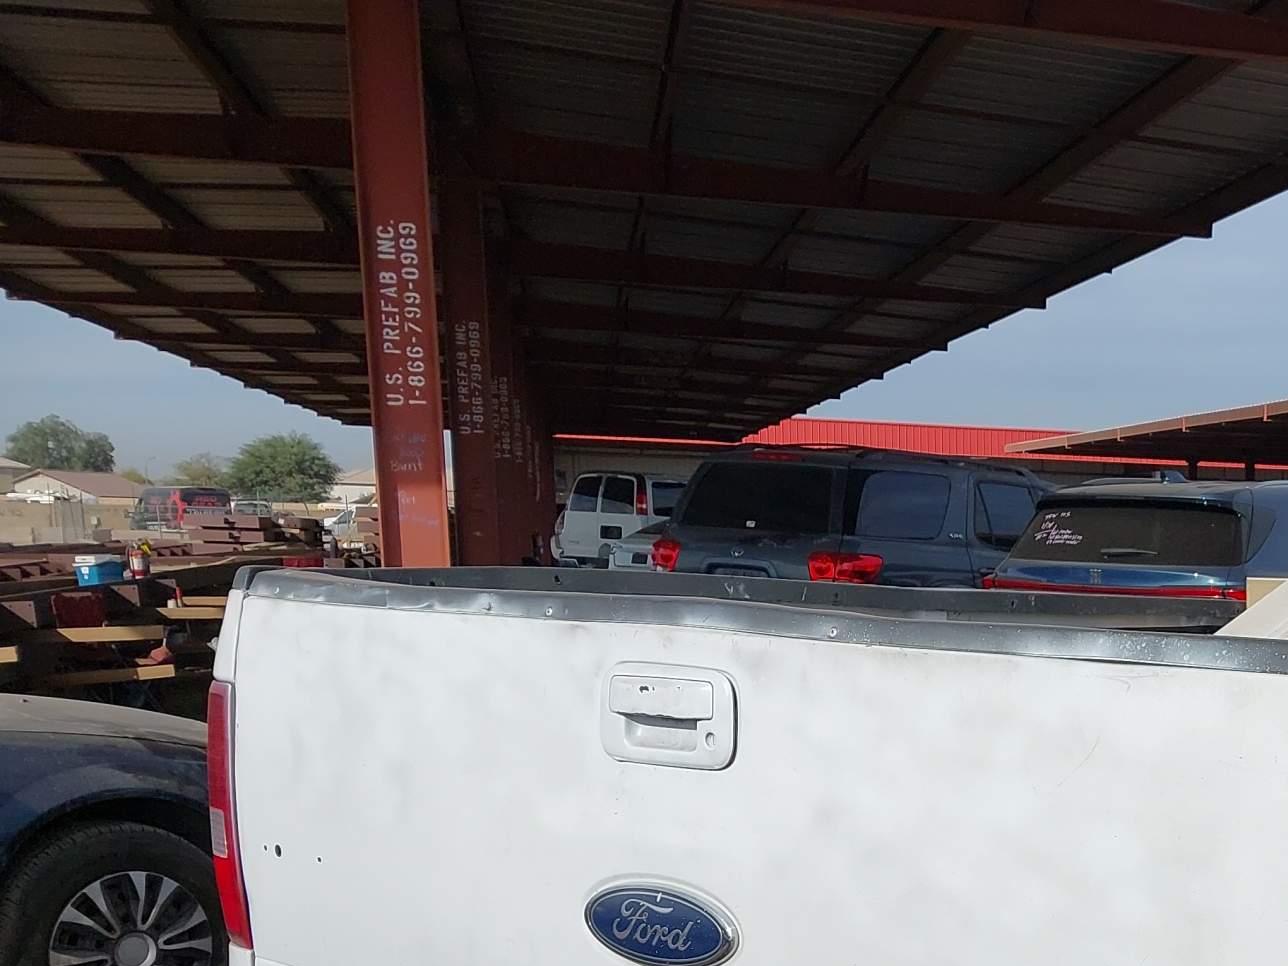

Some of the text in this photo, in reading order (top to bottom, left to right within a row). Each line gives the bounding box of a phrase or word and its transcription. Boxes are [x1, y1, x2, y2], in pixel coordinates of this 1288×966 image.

[376, 219, 404, 406] U.S. PREFAB INC.
[398, 222, 428, 405] 1-866-799-0969
[455, 320, 472, 435] U.S. PREFAB INC.
[468, 321, 485, 434] 1-866-799-0969
[612, 898, 692, 951] Ford
